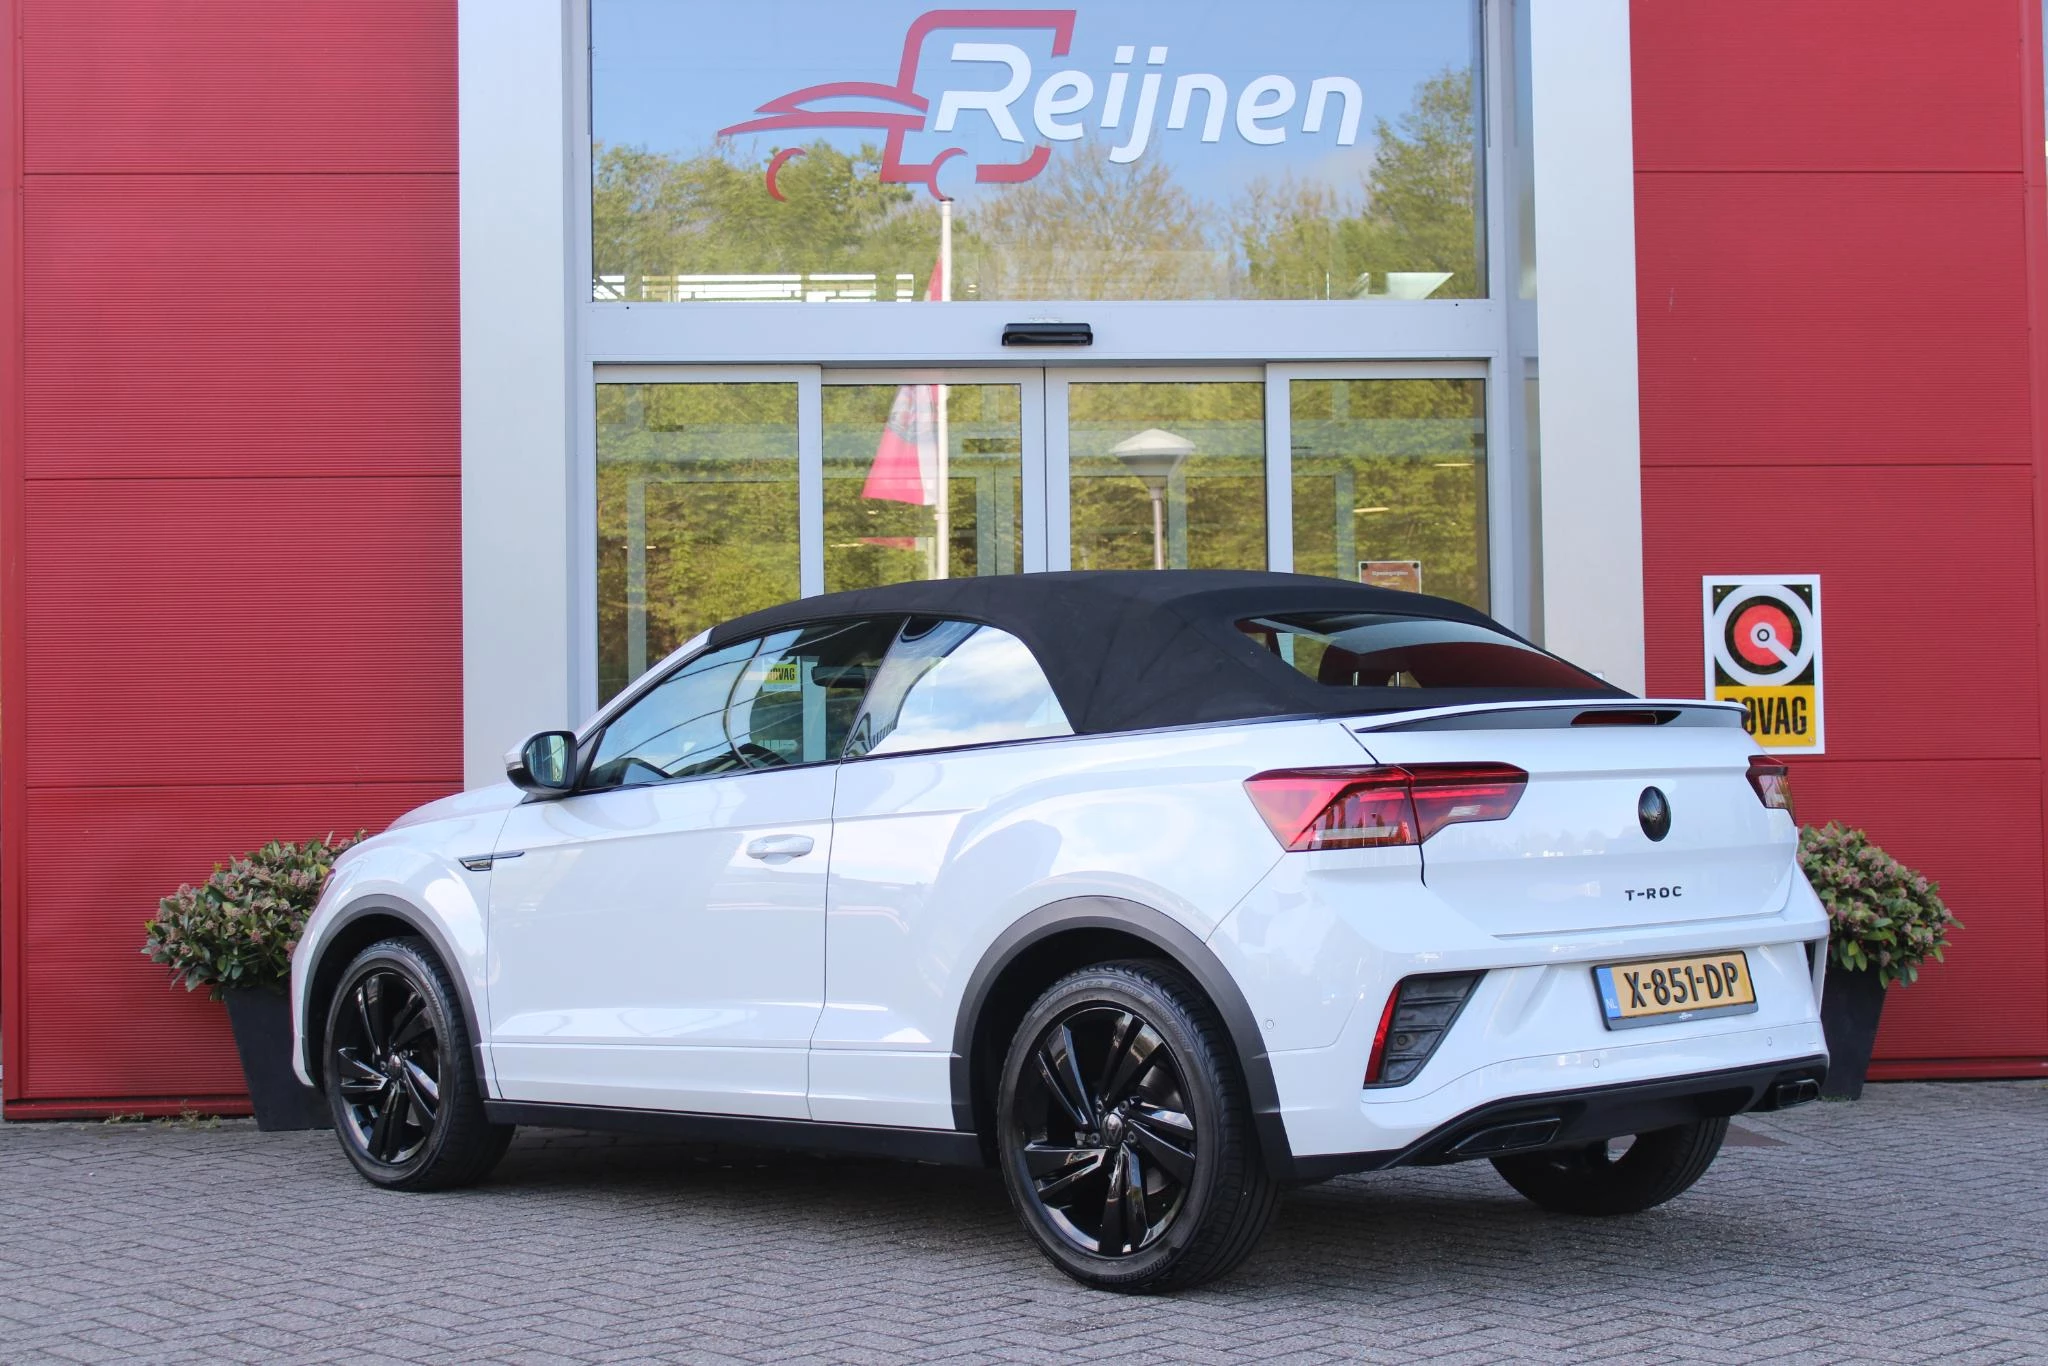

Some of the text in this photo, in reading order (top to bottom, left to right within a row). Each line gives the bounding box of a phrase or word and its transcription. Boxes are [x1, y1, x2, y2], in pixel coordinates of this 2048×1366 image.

[934, 42, 1364, 164] Reijnen
[1724, 696, 1807, 735] OVAG
[1624, 885, 1682, 901] T-ROC
[1605, 998, 1618, 1009] NL
[1624, 961, 1739, 1008] X-851-DP
